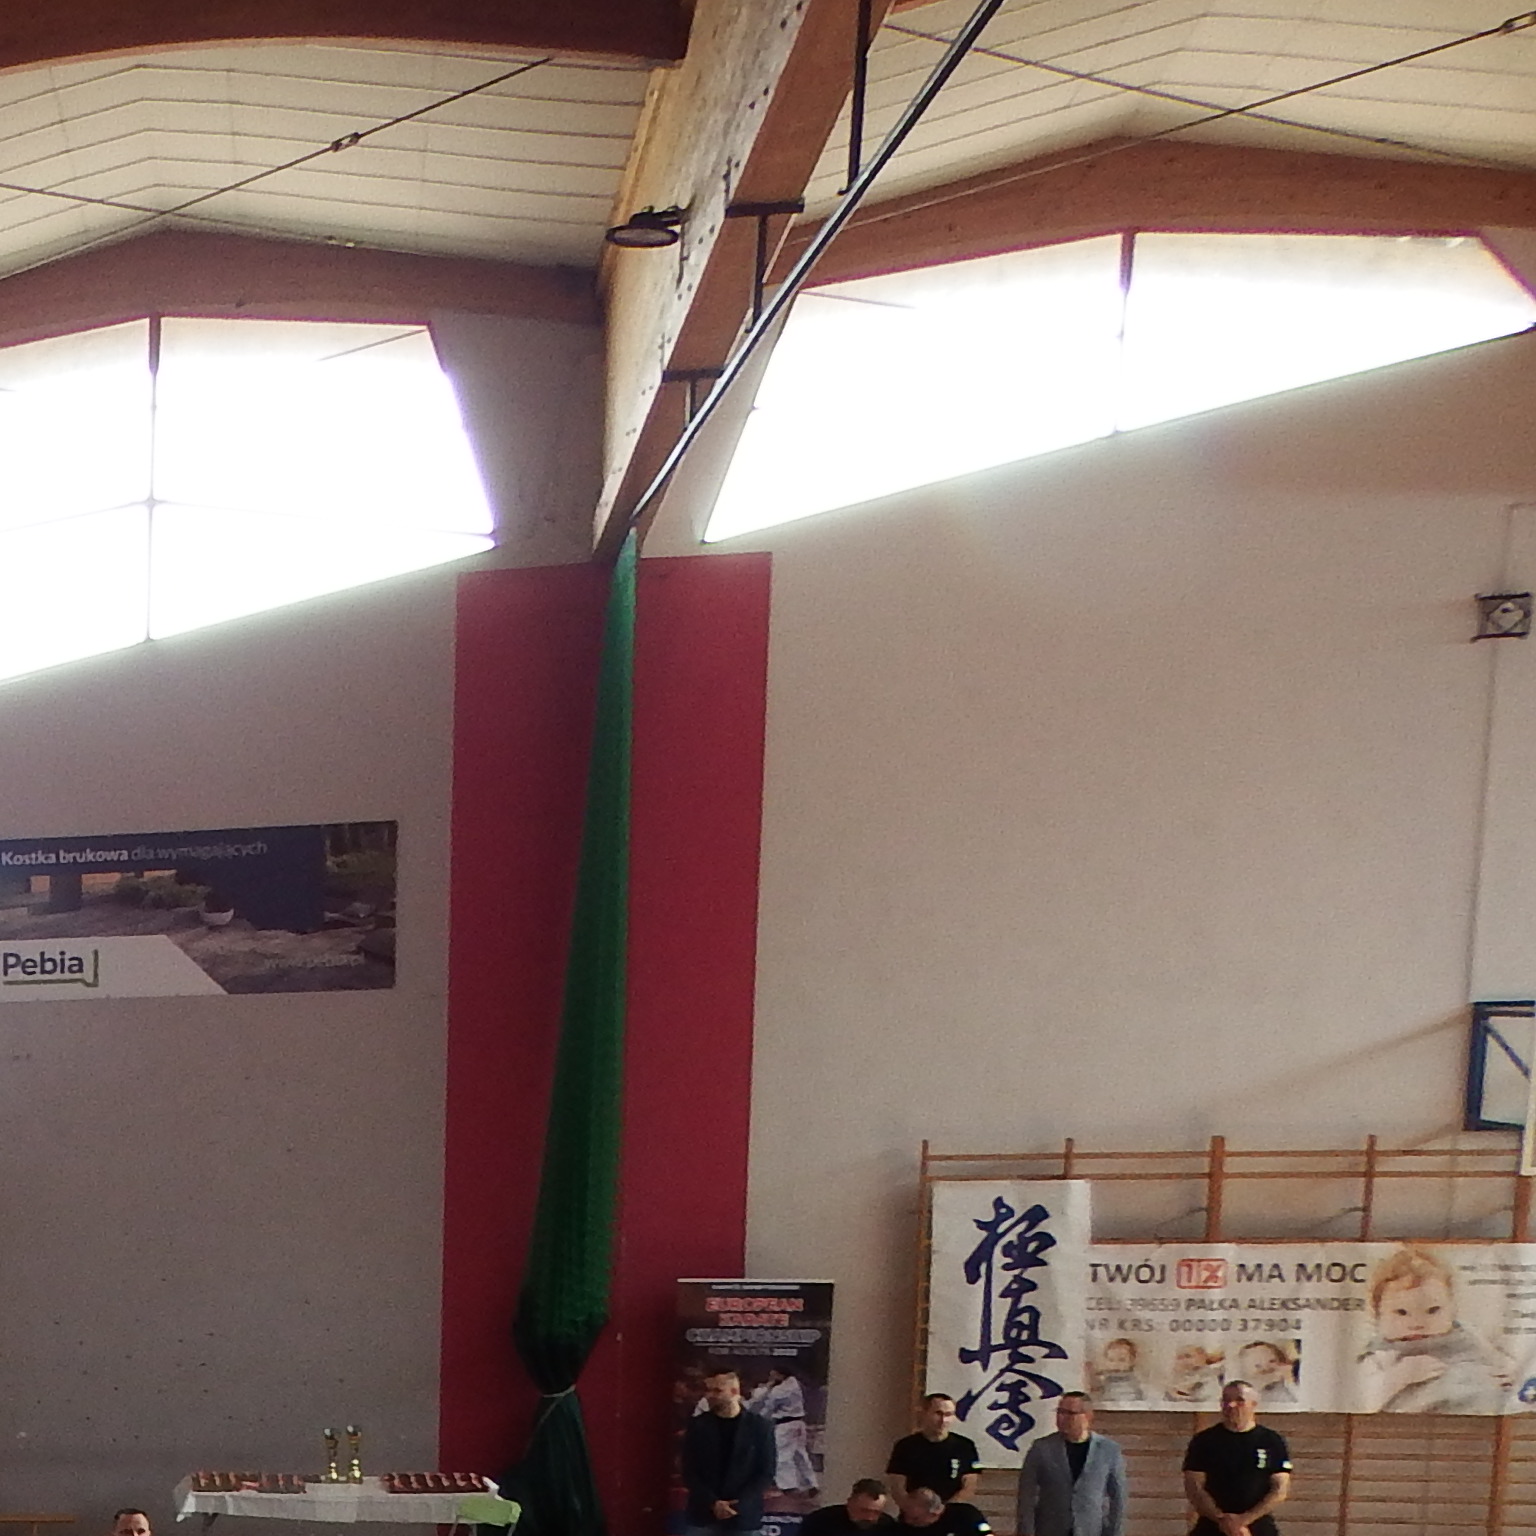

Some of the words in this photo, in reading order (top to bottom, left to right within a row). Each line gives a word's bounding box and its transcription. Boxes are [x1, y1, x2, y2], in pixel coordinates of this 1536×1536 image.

[1, 849, 56, 866] Kostka
[59, 848, 128, 864] brukowa
[2, 950, 84, 977] Pebia
[1089, 1258, 1166, 1284] TWÓJ
[1236, 1263, 1286, 1283] MA
[1295, 1262, 1368, 1284] MOC
[1247, 1297, 1367, 1312] ALEKSANDER
